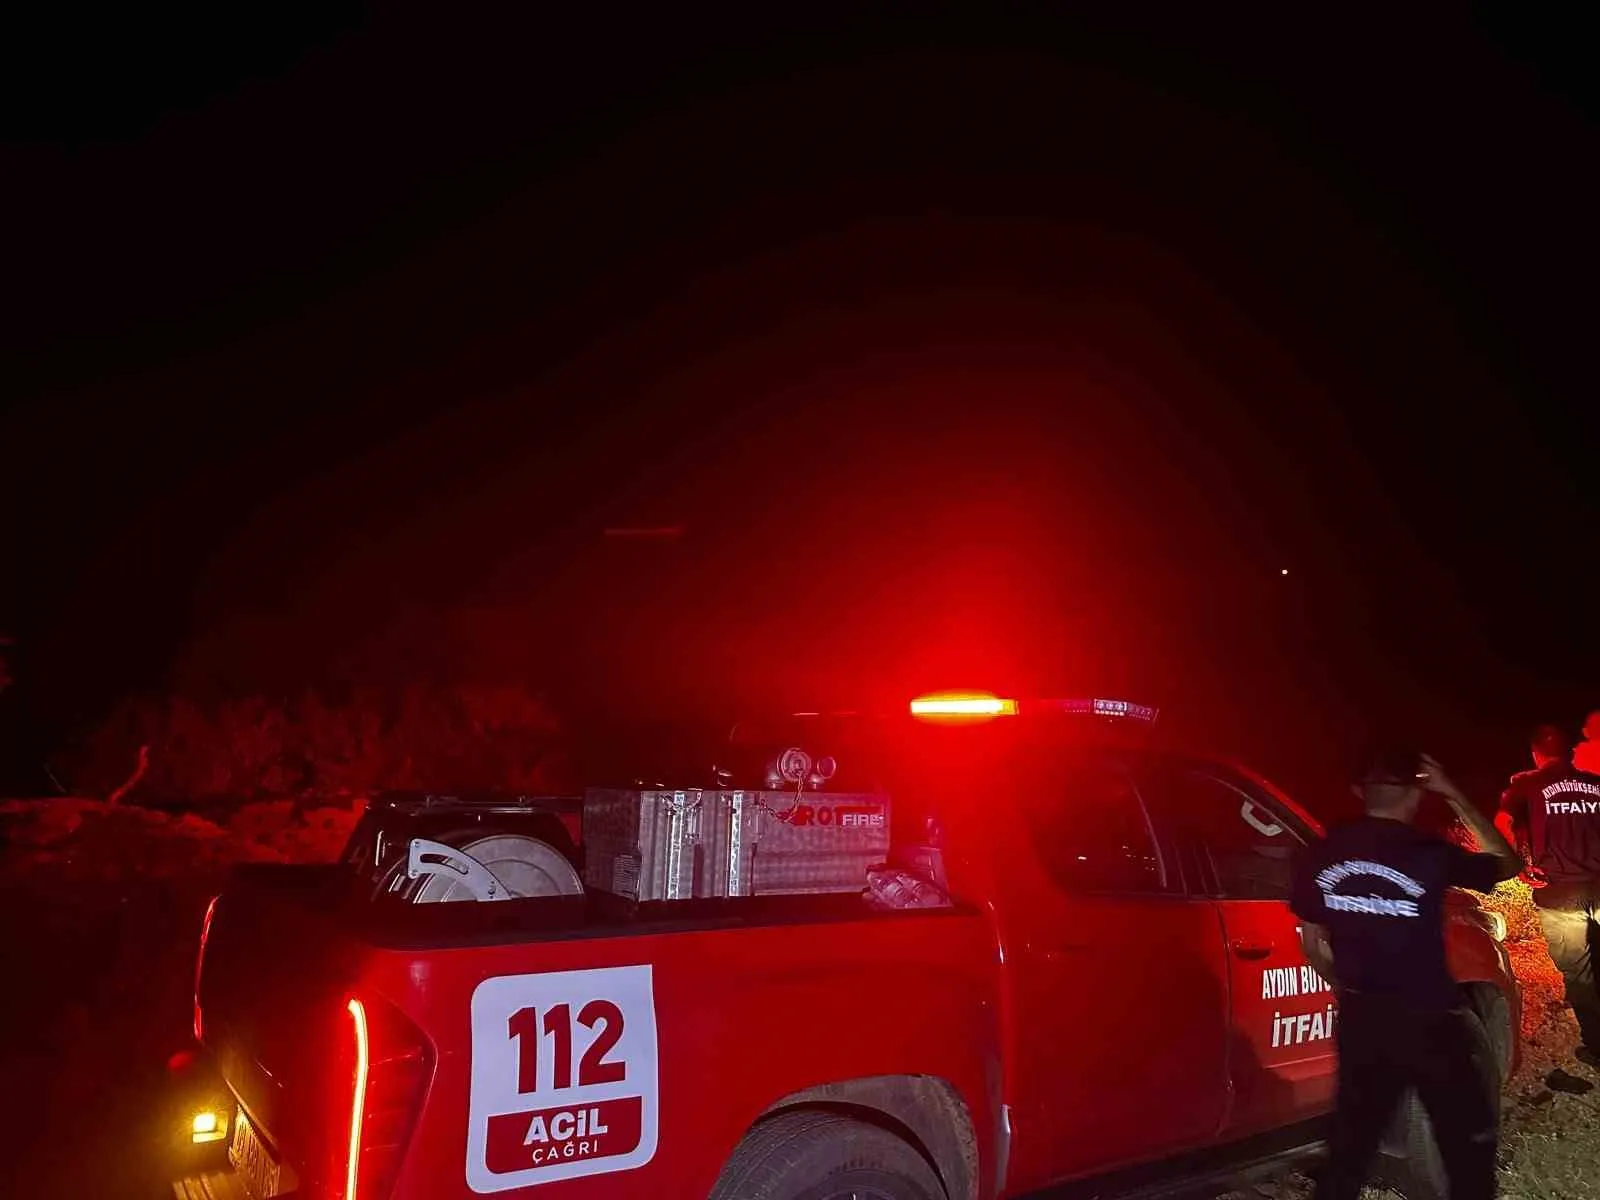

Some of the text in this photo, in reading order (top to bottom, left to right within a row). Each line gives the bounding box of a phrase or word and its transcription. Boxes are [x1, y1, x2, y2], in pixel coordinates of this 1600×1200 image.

[1545, 800, 1600, 815] İTFAİY
[1262, 966, 1297, 1000] AYDIN
[1271, 1003, 1337, 1048] İTFAİ
[508, 1000, 626, 1094] 112
[532, 1140, 598, 1164] ÇAĞRI
